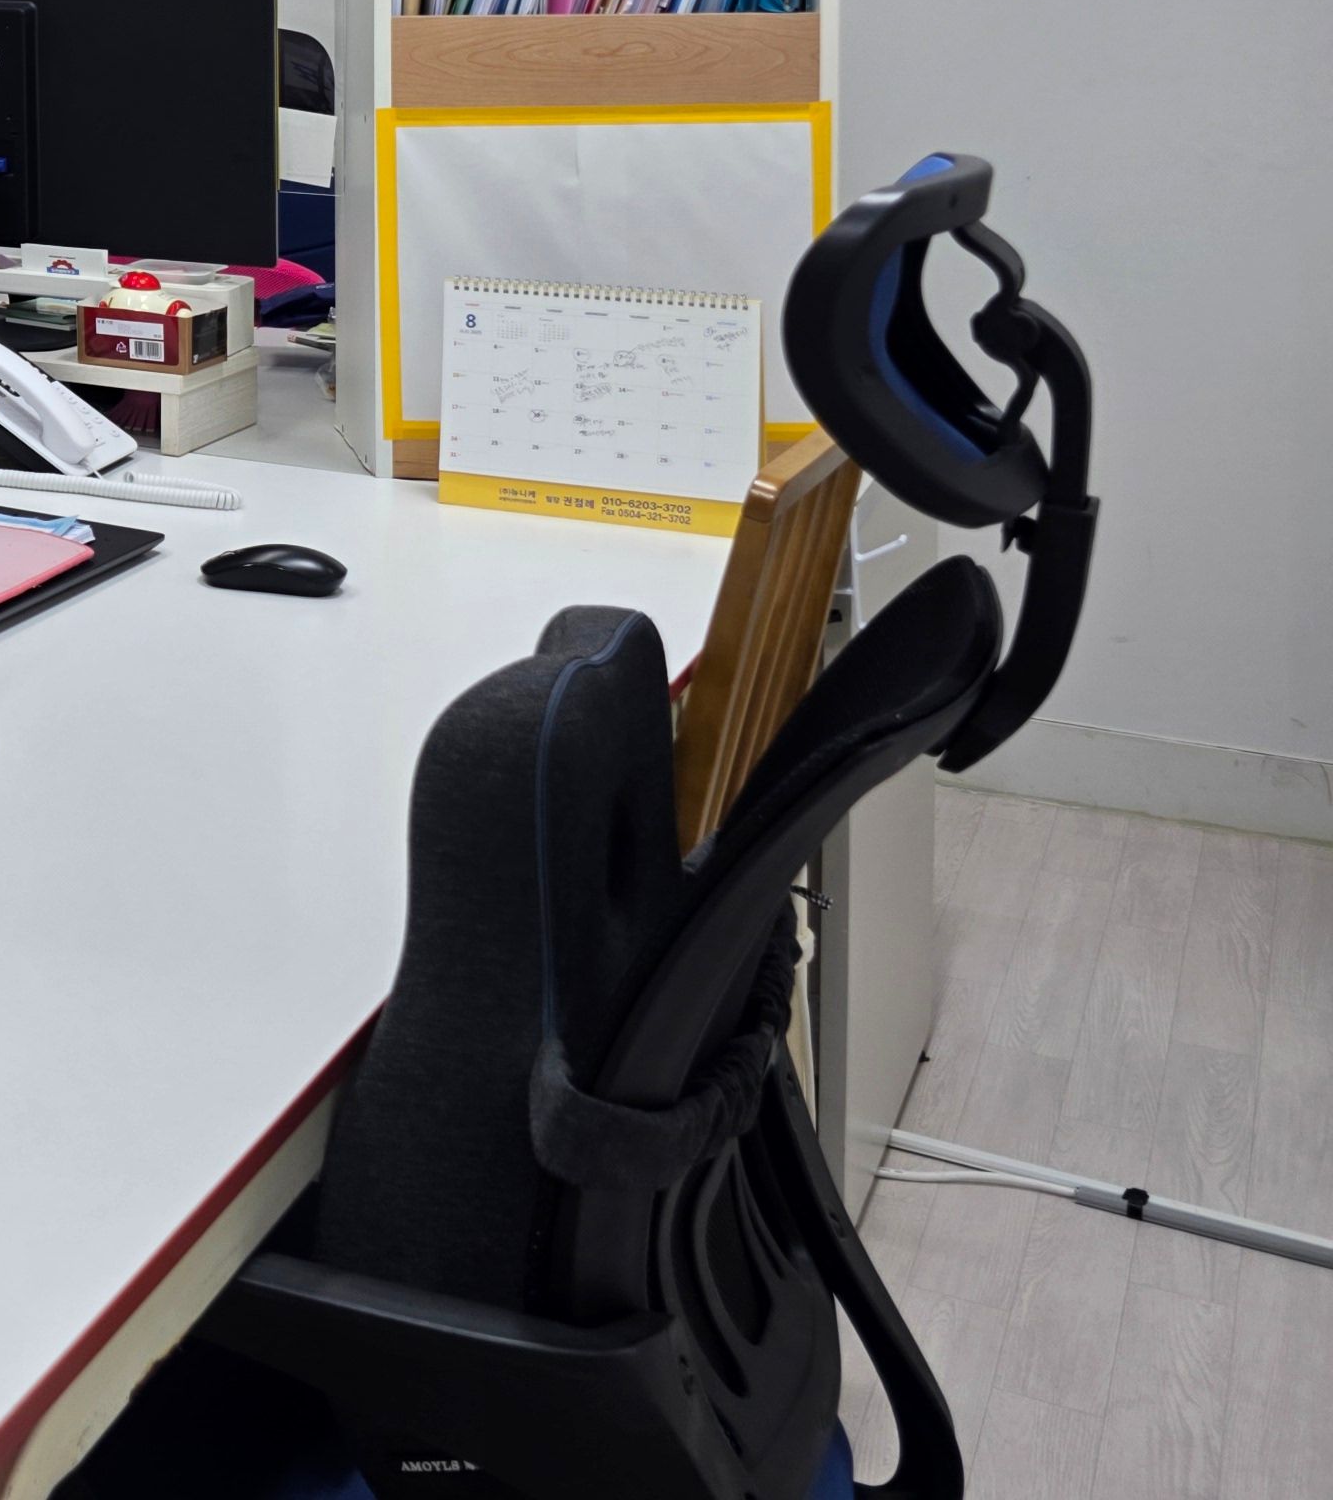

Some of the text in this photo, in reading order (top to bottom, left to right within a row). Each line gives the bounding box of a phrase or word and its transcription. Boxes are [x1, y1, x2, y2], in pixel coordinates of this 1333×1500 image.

[465, 313, 477, 328] 8
[601, 496, 692, 515] 010-6203-3702
[601, 506, 691, 525] Fax 0504-321-3702
